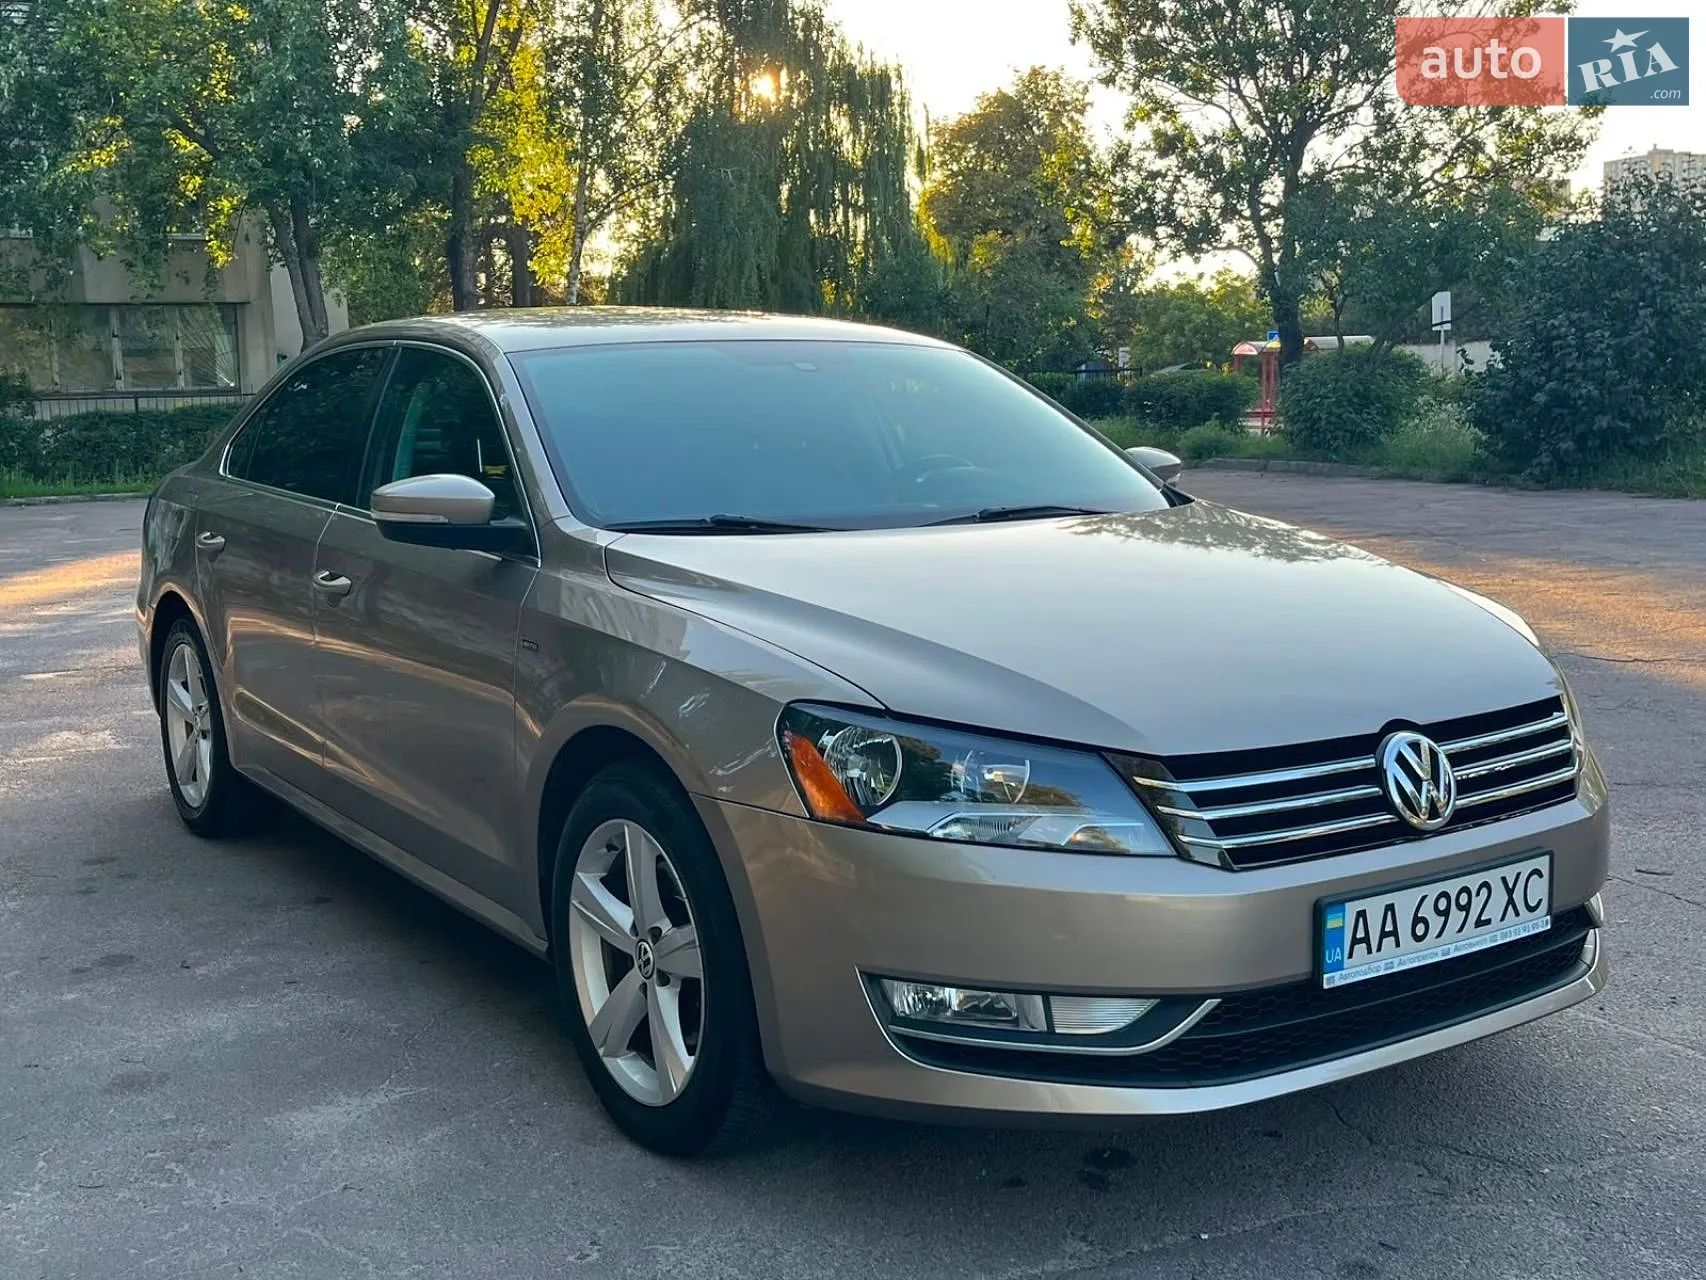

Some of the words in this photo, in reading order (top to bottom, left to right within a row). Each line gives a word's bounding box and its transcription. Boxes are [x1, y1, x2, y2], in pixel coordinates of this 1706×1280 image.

[1384, 732, 1454, 829] VW
[1325, 947, 1342, 963] UA
[1347, 902, 1401, 959] AA
[1410, 880, 1492, 943] 6992
[1499, 867, 1544, 922] XC
